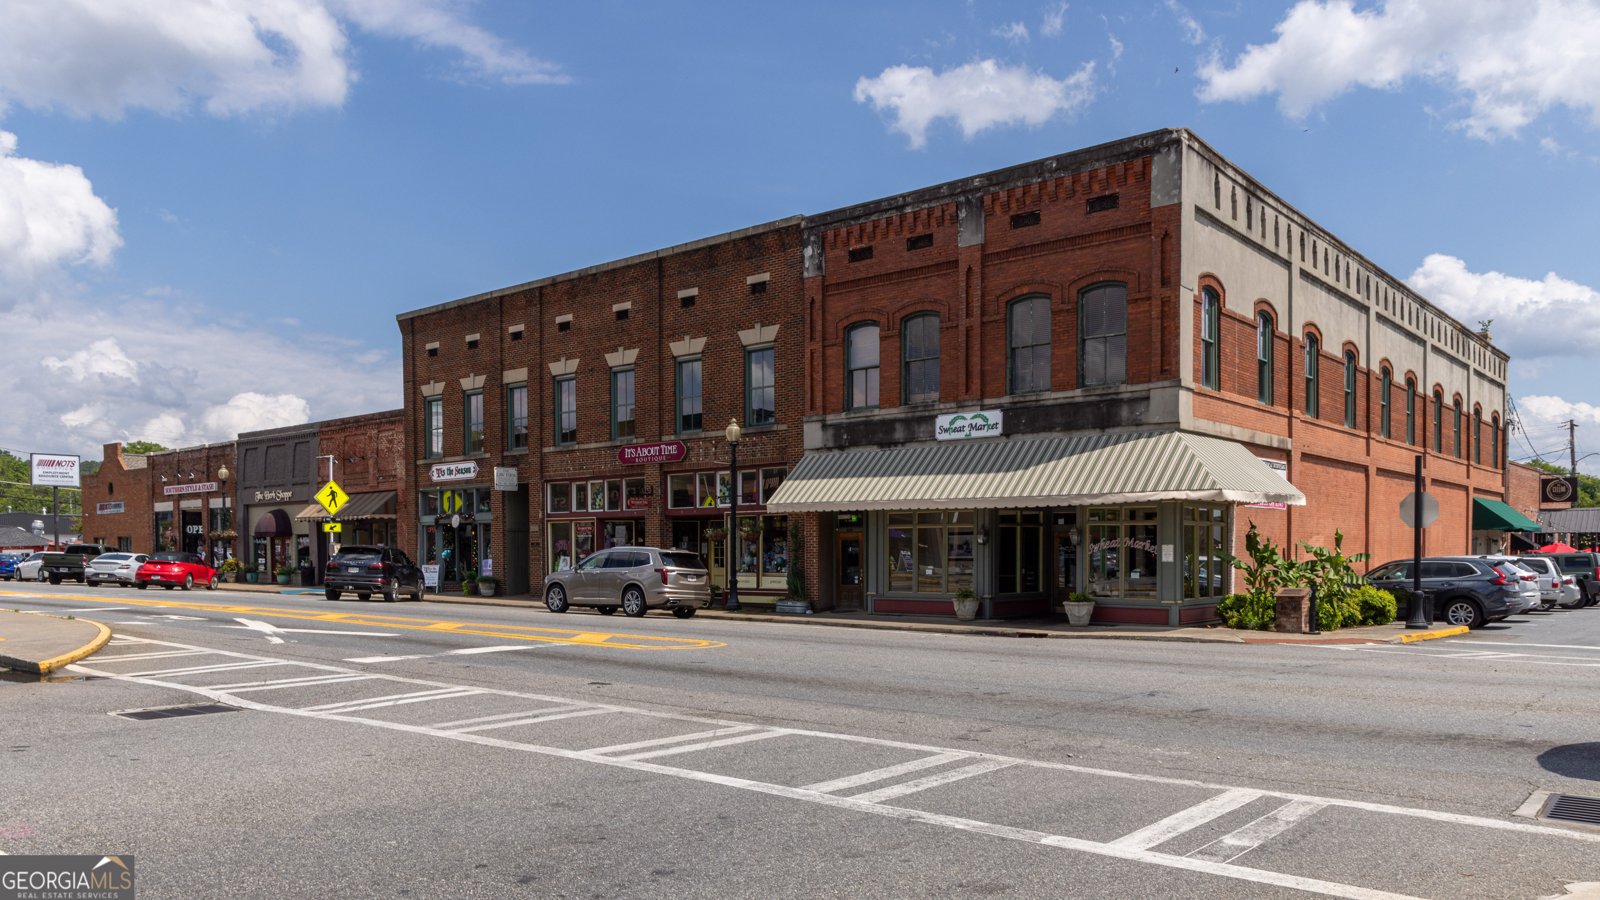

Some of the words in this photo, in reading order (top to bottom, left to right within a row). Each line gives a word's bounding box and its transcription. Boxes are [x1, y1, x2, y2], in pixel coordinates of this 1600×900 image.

[968, 421, 999, 432] Market
[636, 447, 660, 457] ABOUT
[661, 444, 678, 455] TIME
[55, 459, 76, 468] NOTS
[446, 467, 454, 476] the
[455, 466, 471, 476] Season
